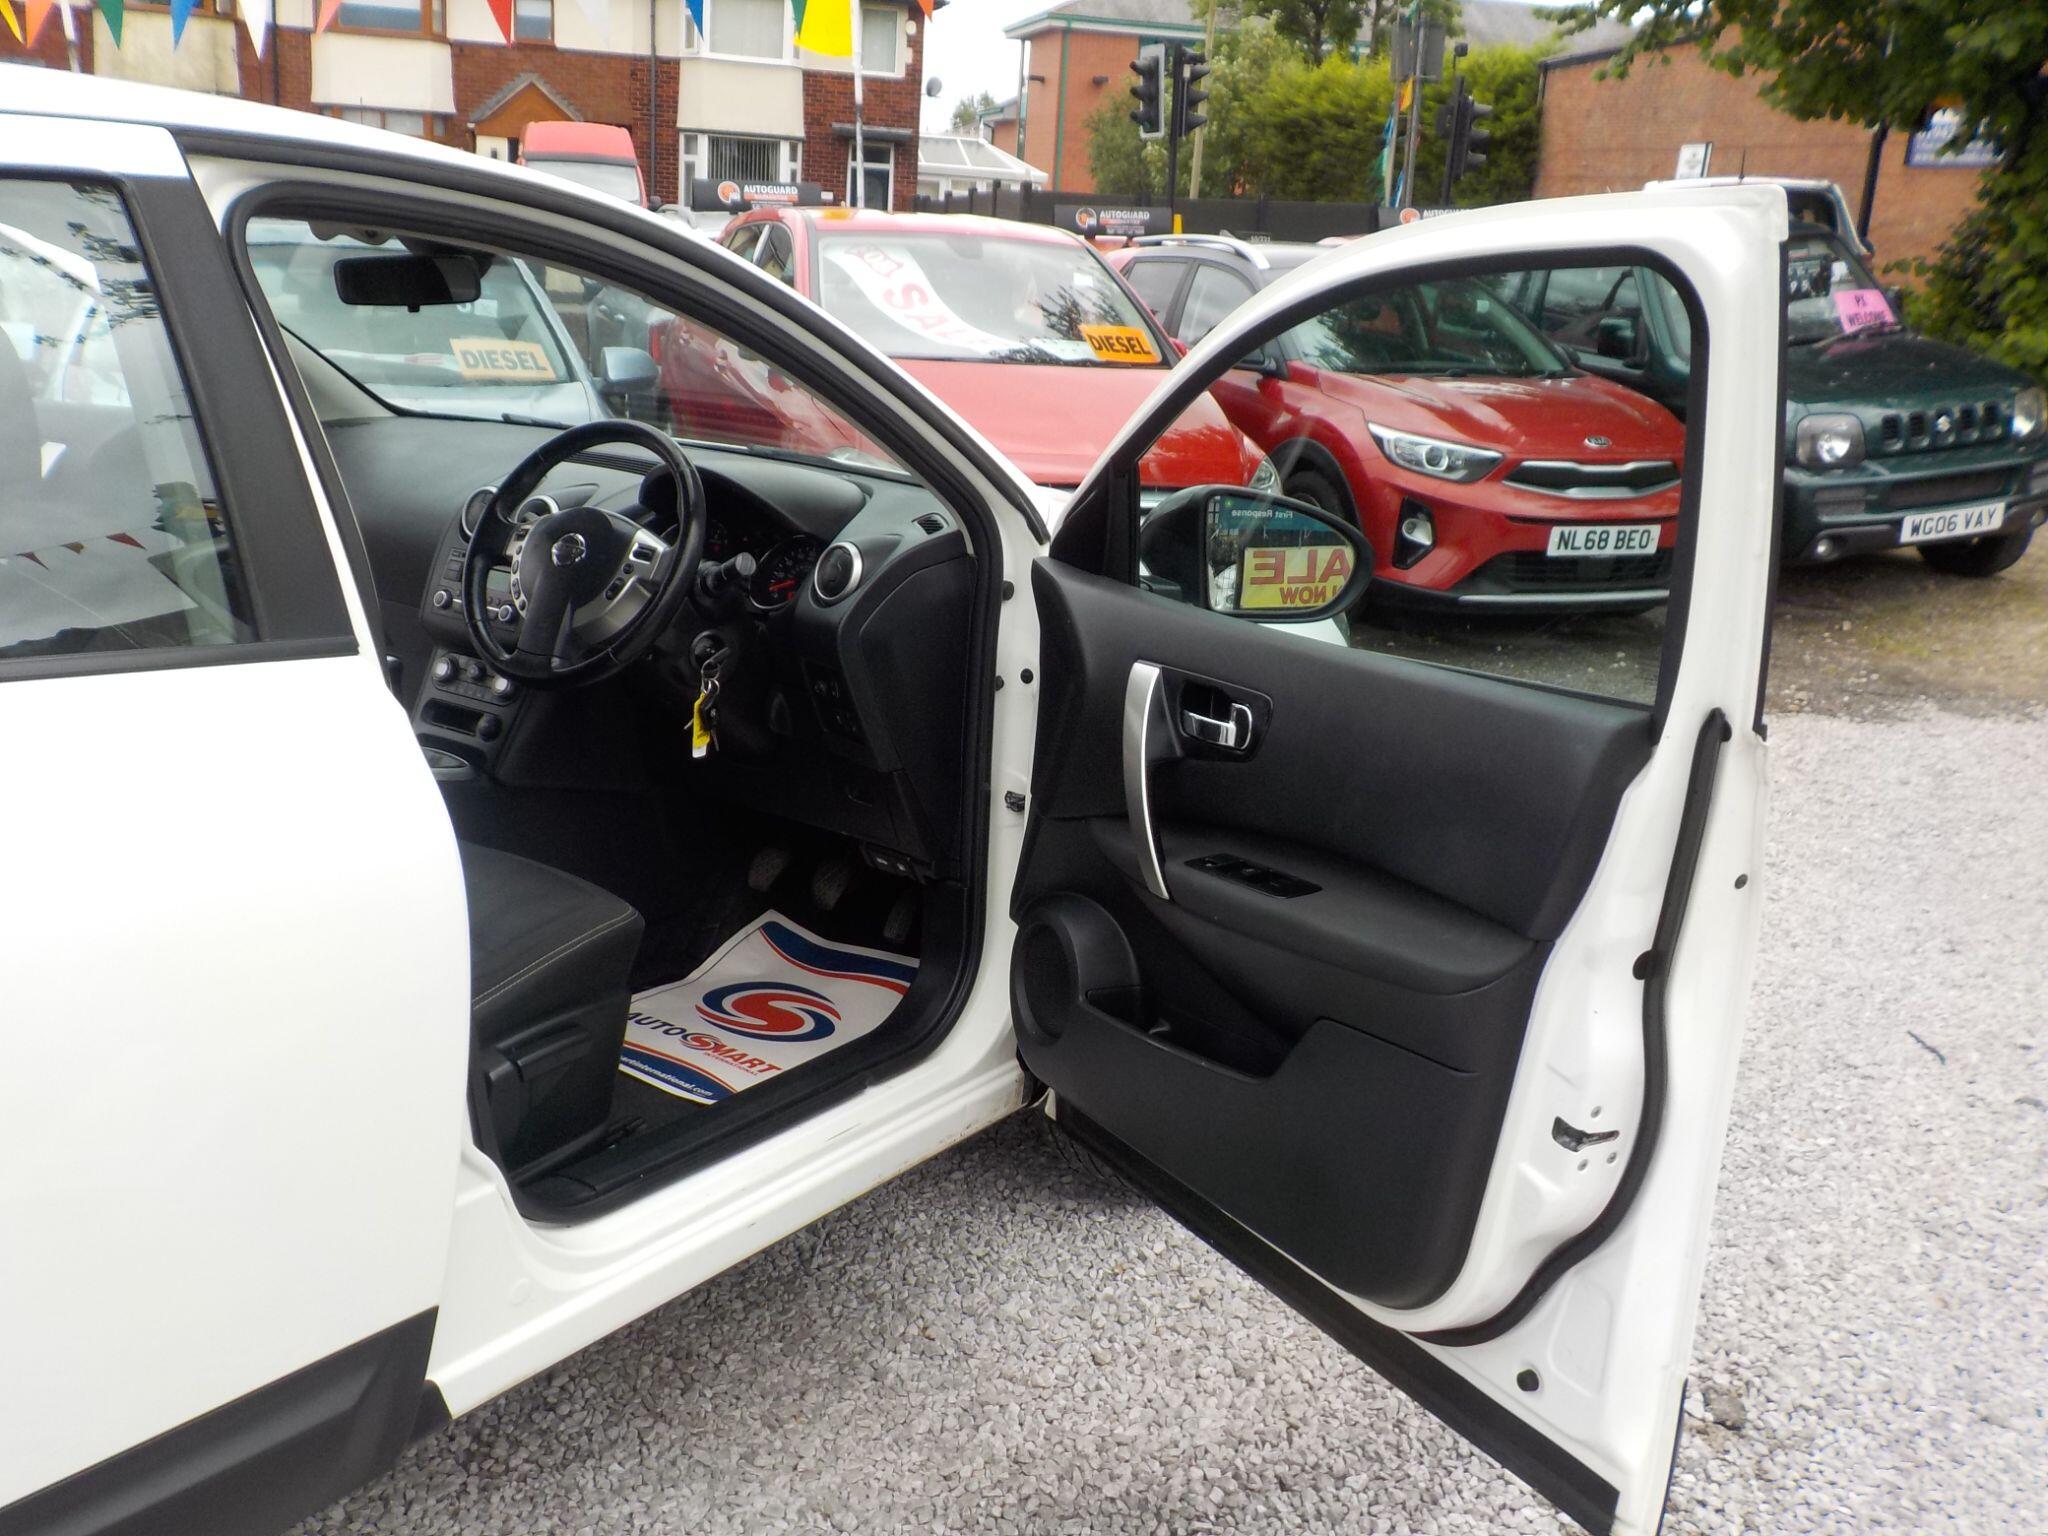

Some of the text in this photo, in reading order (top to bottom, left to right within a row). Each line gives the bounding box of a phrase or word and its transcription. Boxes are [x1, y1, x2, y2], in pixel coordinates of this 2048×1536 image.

[743, 184, 799, 195] AUTOGUARD
[1099, 210, 1150, 221] AUTOGUARD
[1086, 333, 1152, 355] DIESEL
[460, 349, 549, 371] DIESEL
[1910, 506, 1998, 538] WG06 VAY
[1556, 528, 1651, 551] NL68 BEO
